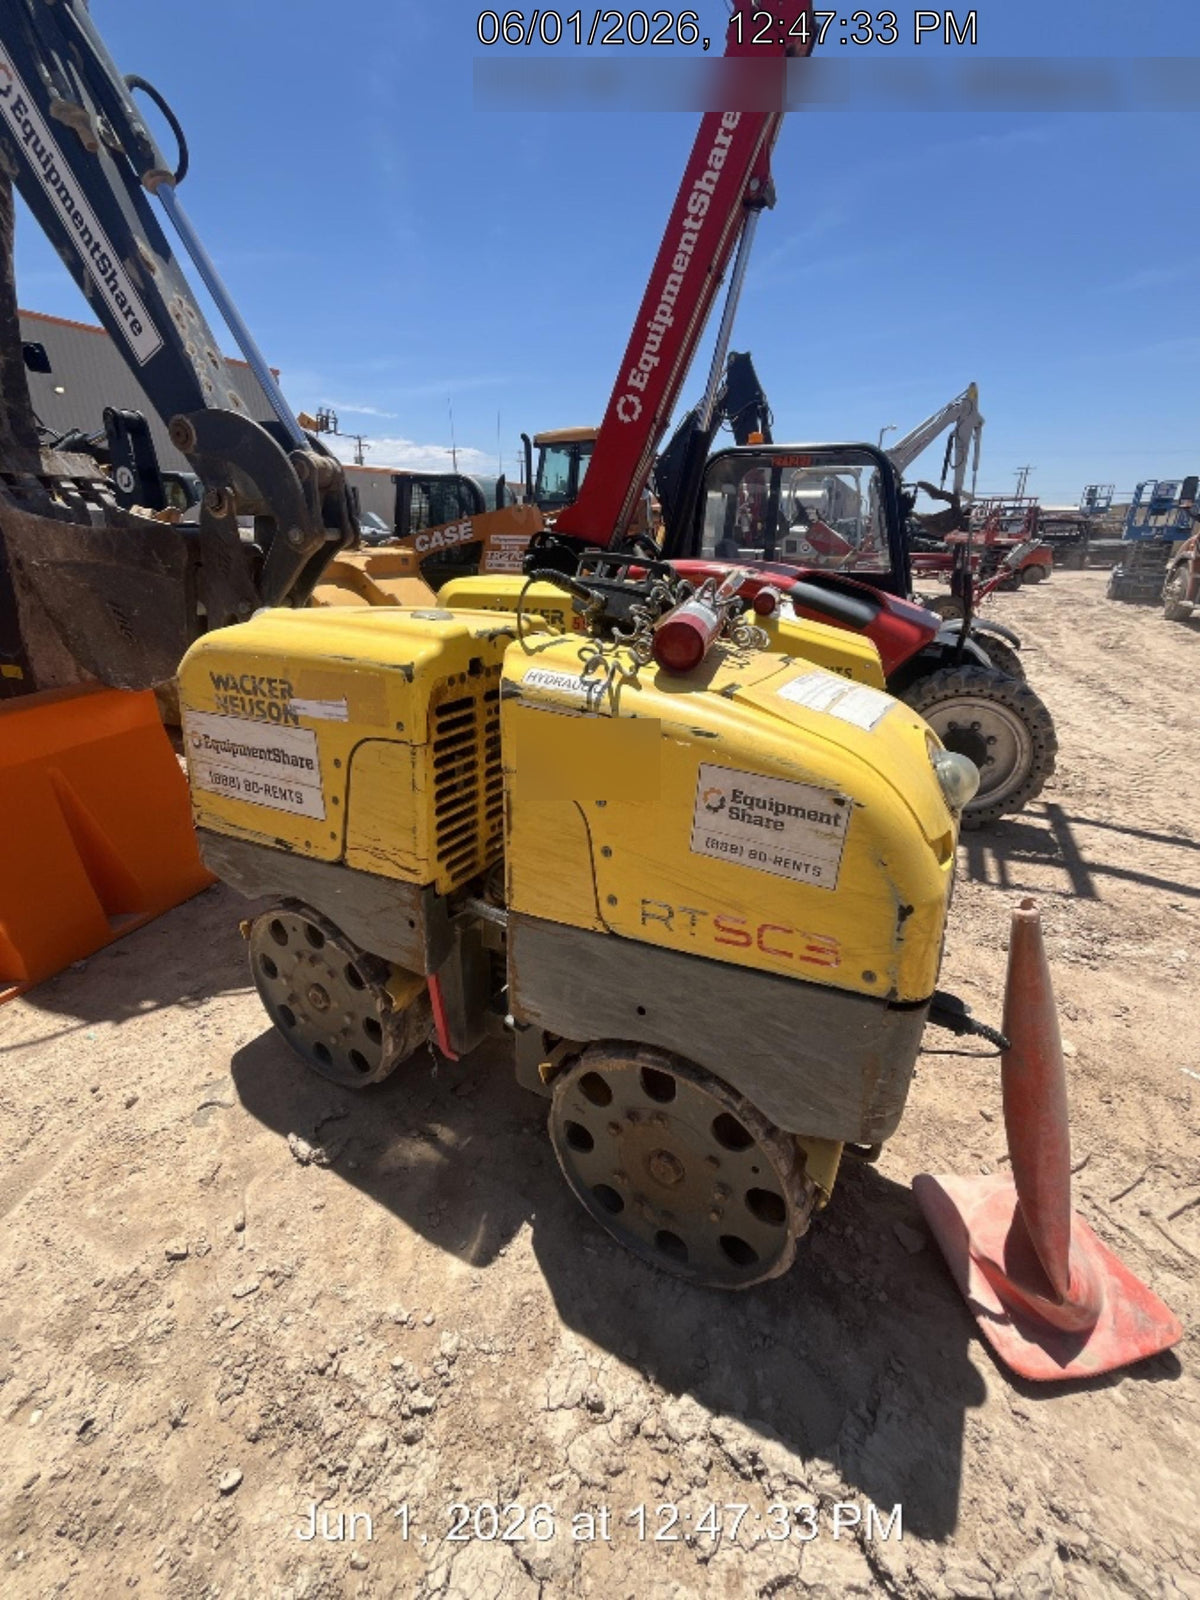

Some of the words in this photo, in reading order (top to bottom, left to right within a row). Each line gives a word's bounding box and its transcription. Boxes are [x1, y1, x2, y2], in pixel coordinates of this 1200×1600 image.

[9, 93, 143, 338] EquipmentShare
[627, 111, 742, 392] EquipmentShare
[415, 520, 474, 552] CASE
[208, 671, 295, 699] WACKER
[526, 670, 605, 697] HYDRAU
[214, 694, 300, 725] NEUSON
[202, 733, 315, 771] EquipmentShare
[209, 770, 242, 791] (888)
[244, 780, 304, 805] 80-RENTS
[728, 806, 785, 832] Share
[730, 788, 842, 828] Equipment
[705, 836, 744, 858] (888)
[748, 848, 823, 878] 80-RENTS
